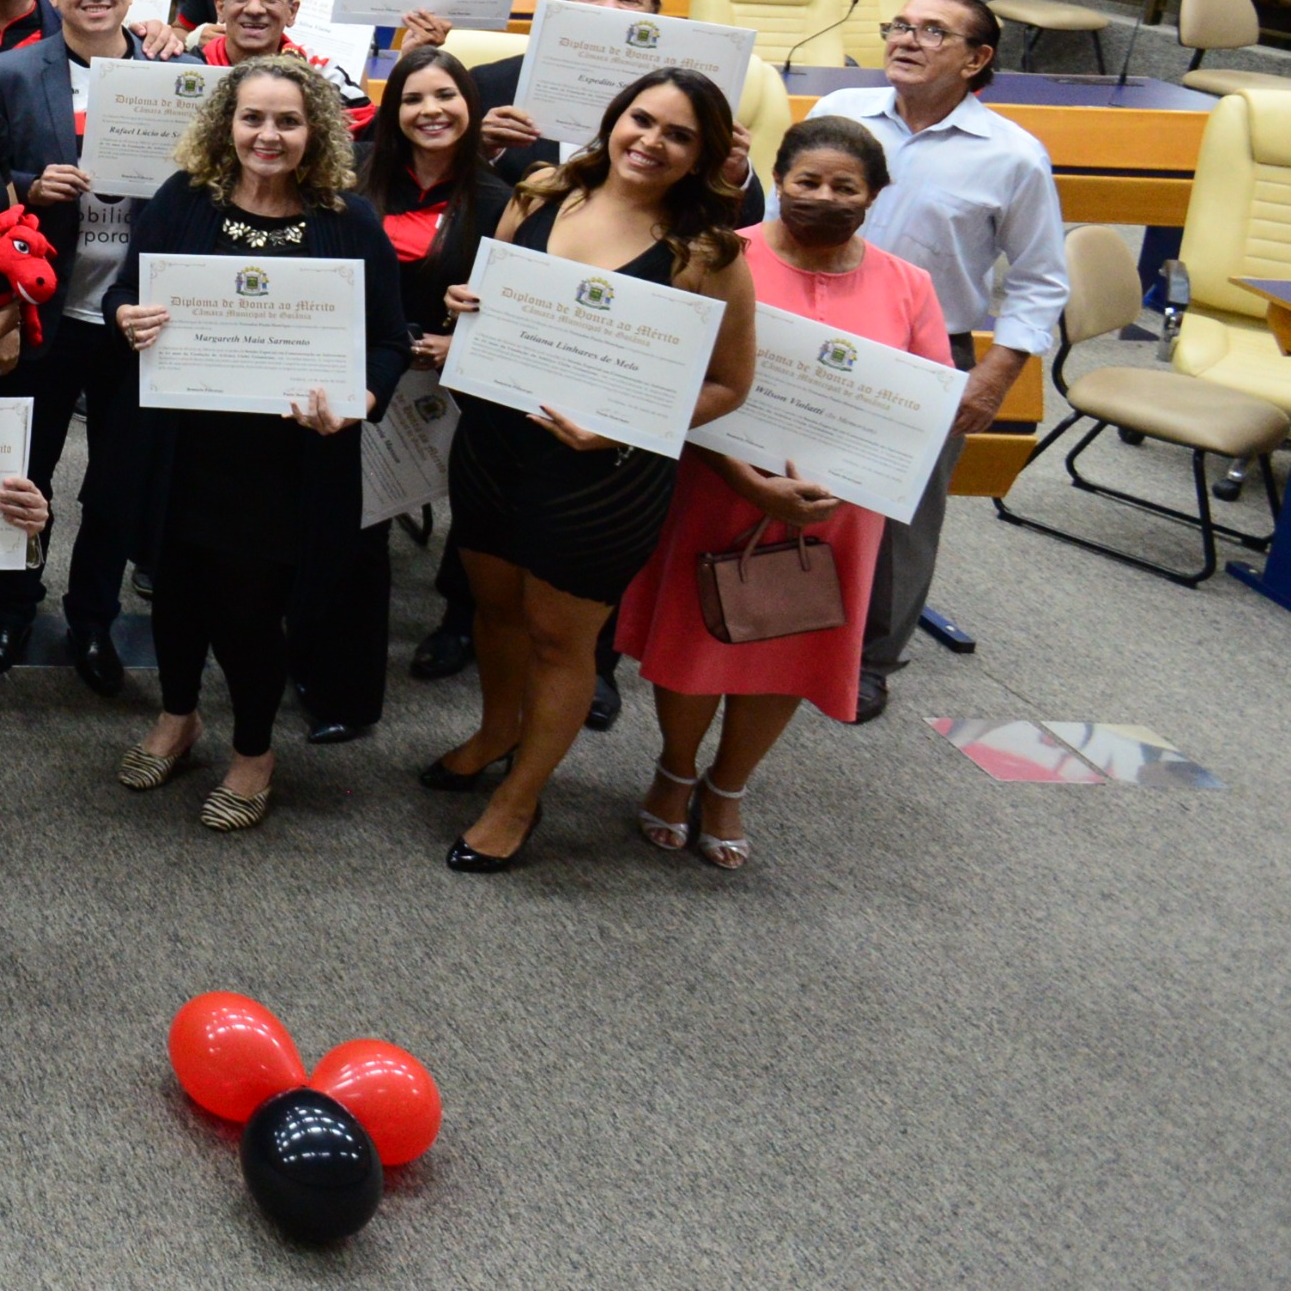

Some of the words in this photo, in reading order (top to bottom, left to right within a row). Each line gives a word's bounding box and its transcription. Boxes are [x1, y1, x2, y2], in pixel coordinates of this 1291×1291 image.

[194, 333, 240, 344] Margareth
[243, 336, 265, 344] Maia
[267, 337, 311, 346] Sarmento
[519, 330, 553, 347] Tatiana
[556, 341, 598, 360] Linhares
[600, 353, 612, 363] de
[615, 357, 639, 371] Melo
[756, 348, 793, 368] ploma
[755, 384, 788, 402] Wilson
